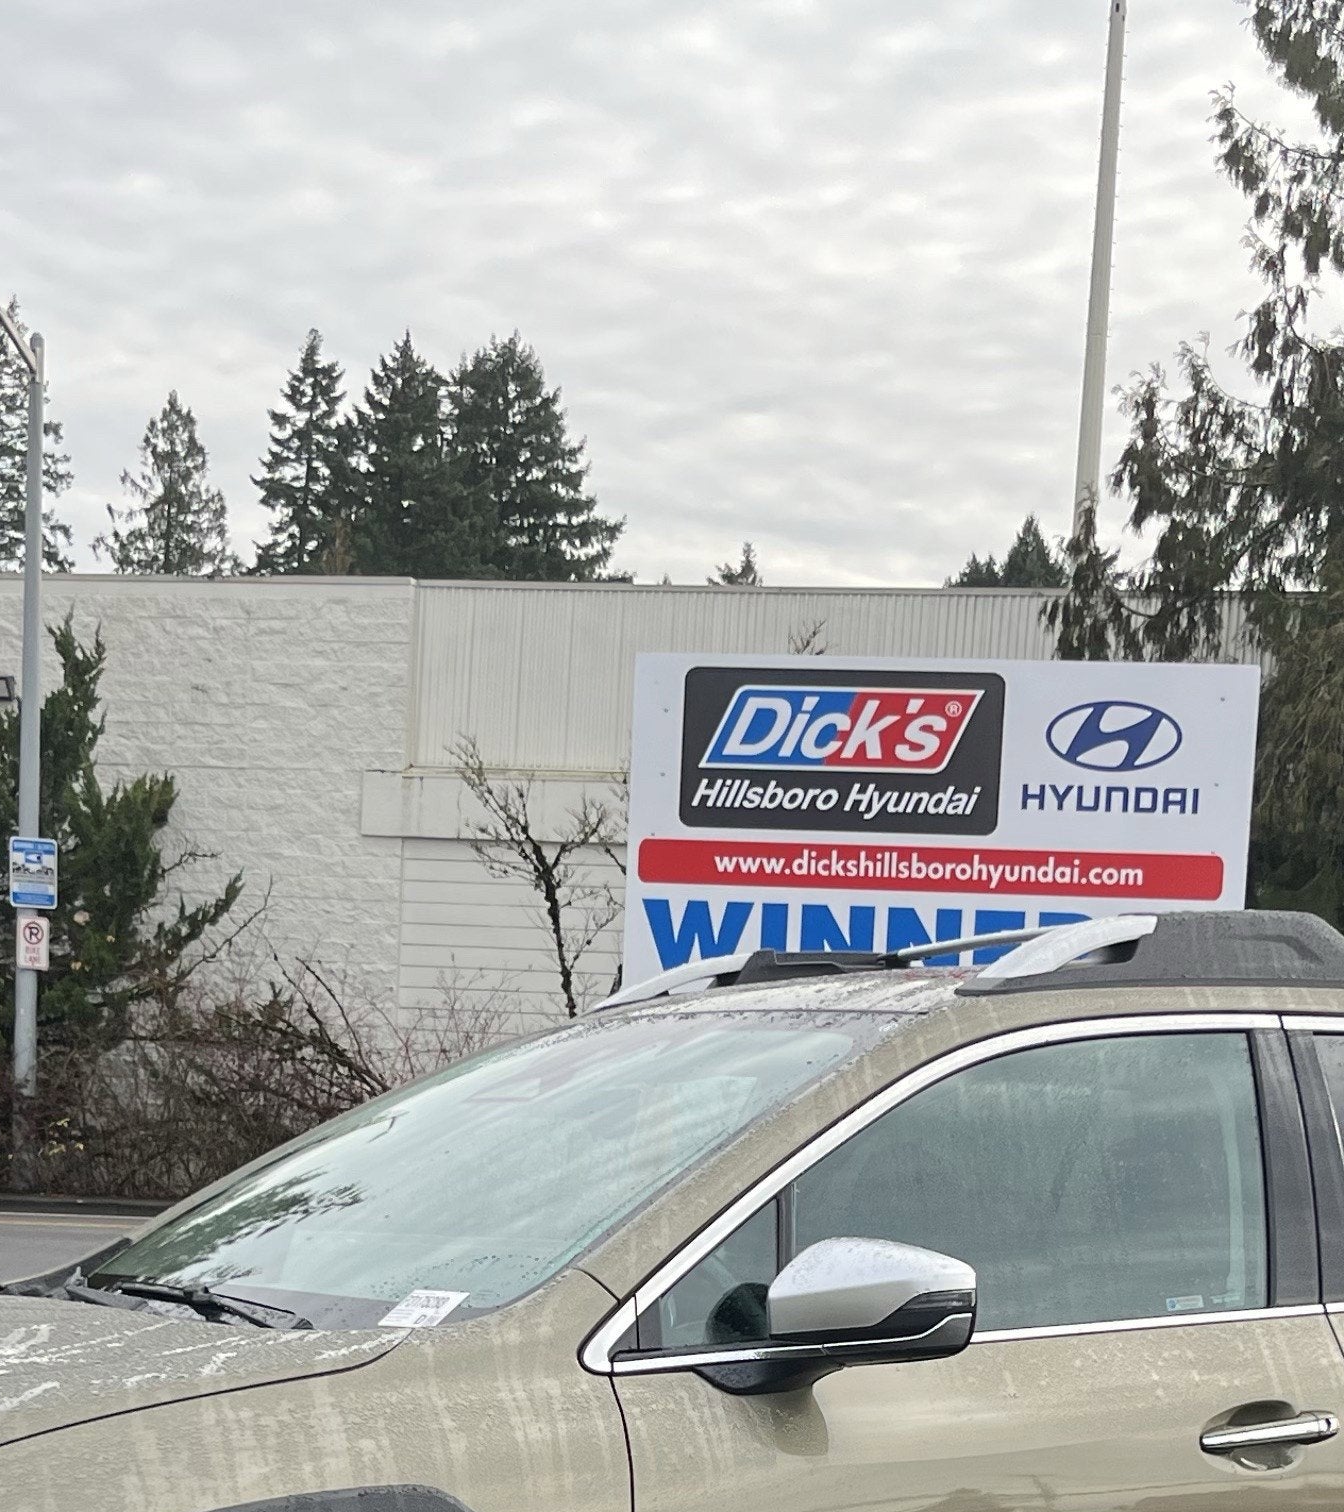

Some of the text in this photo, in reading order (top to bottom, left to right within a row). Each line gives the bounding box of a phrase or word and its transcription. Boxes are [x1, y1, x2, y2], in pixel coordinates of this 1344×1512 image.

[721, 696, 947, 762] Dick's
[691, 778, 981, 820] Hillsboro Hyundai
[1021, 783, 1200, 815] HYUNDAI
[714, 849, 1143, 888] www.dickshillsborohyundai.com
[642, 898, 1093, 971] WINNE
